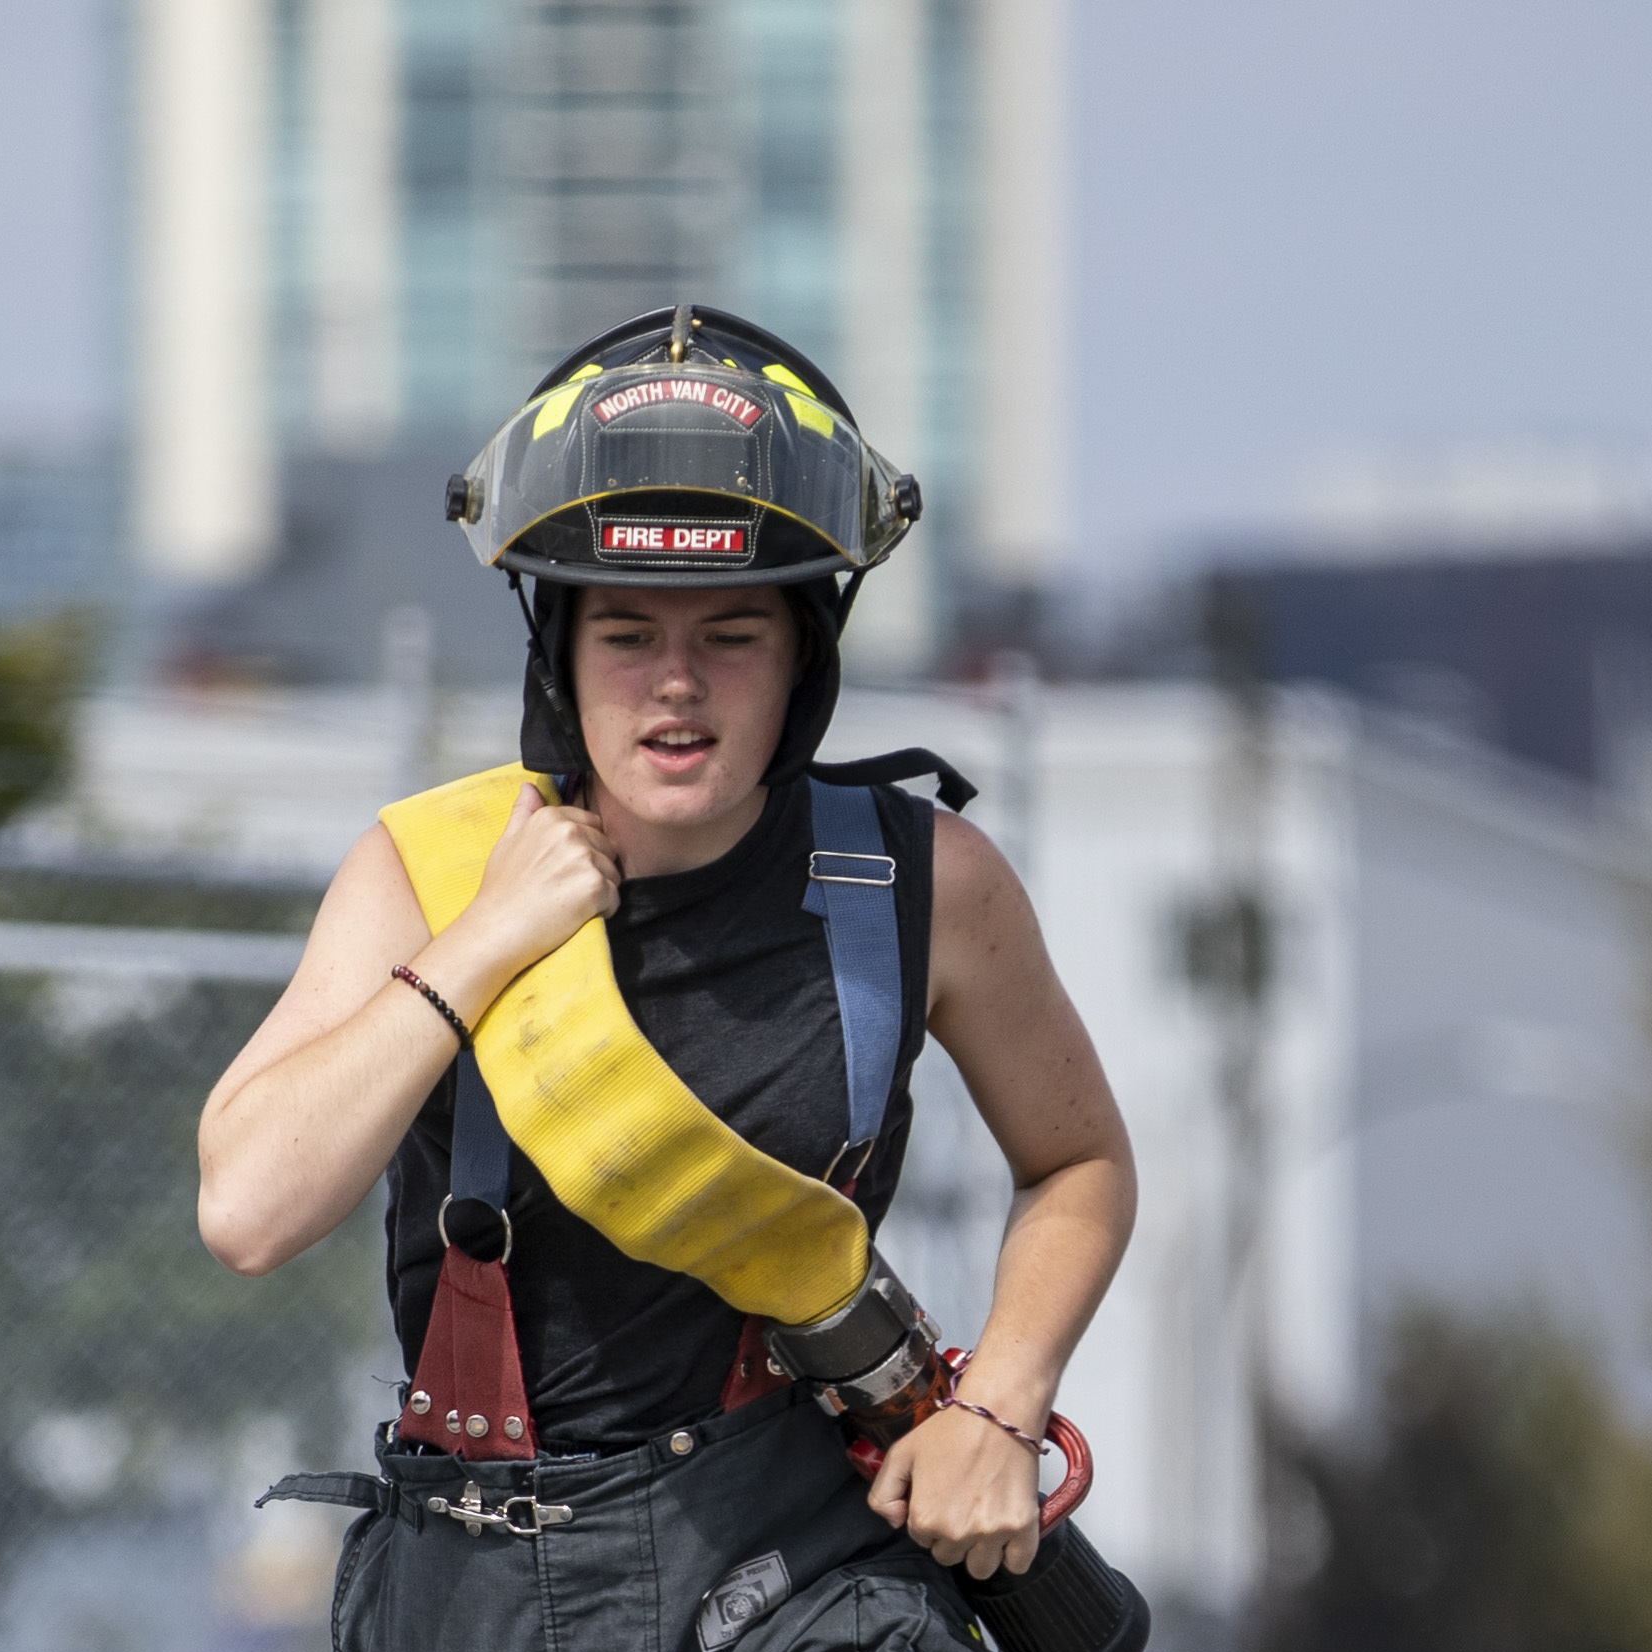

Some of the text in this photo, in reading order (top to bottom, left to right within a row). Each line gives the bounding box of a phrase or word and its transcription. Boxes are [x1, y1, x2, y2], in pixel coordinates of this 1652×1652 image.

[599, 380, 757, 420] NORTH VAN CITY
[612, 526, 736, 549] FIRE DEPT
